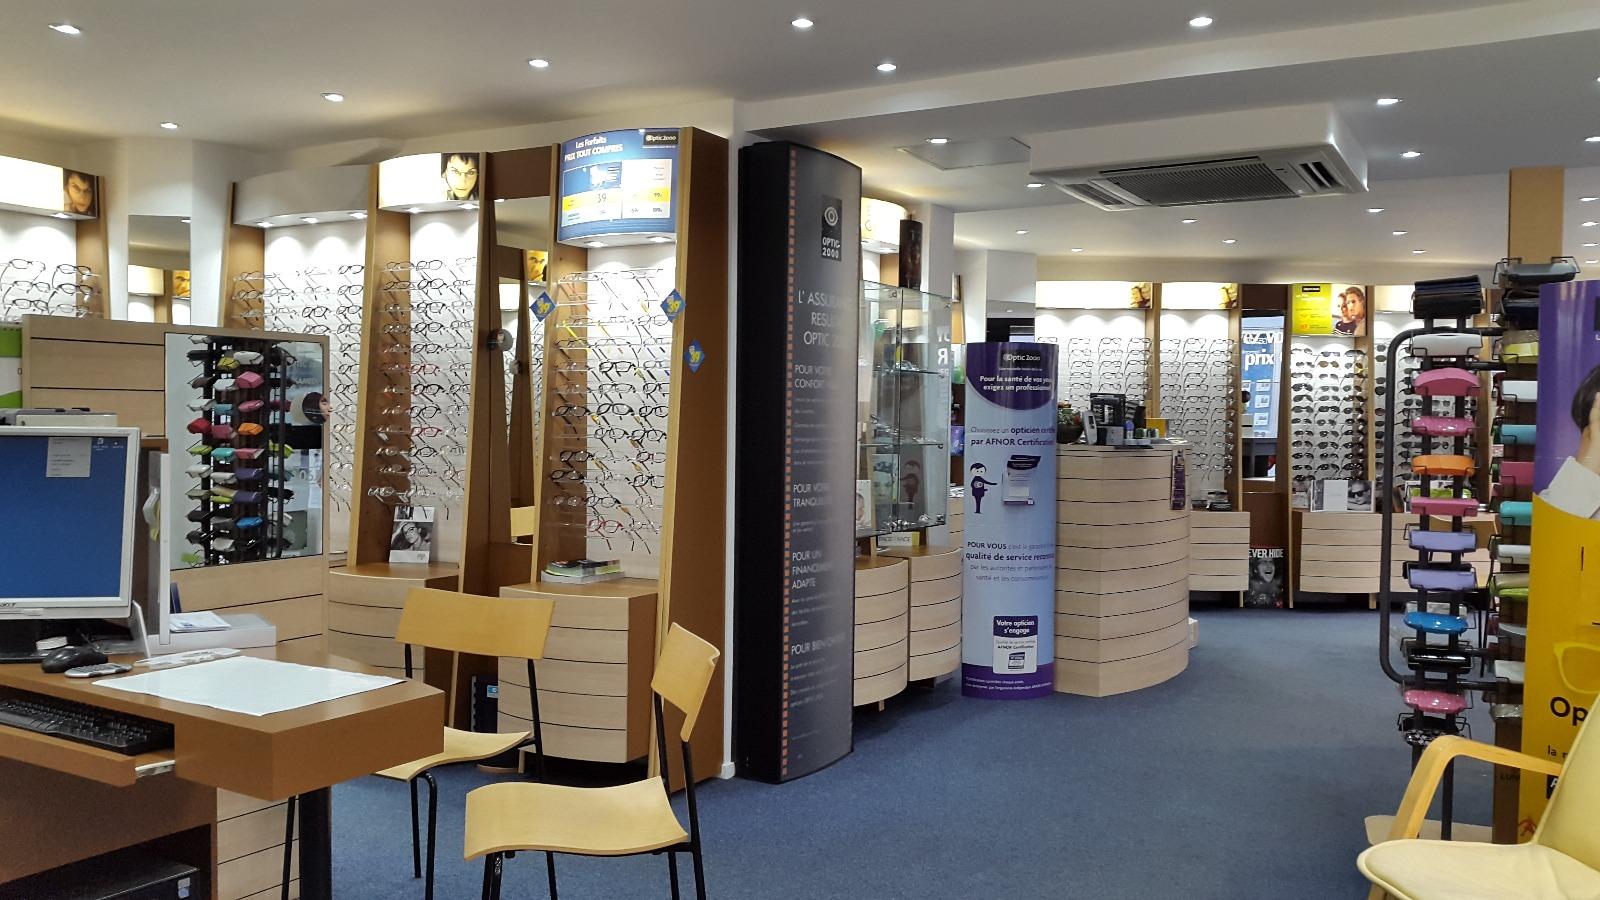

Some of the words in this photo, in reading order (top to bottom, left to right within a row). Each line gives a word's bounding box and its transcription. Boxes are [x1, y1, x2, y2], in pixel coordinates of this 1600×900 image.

[575, 141, 585, 149] Les
[585, 136, 607, 147] Forfaits
[564, 151, 576, 163] PRIX
[576, 149, 591, 159] TOUT
[591, 144, 624, 156] COMPRIS
[822, 237, 841, 248] OPTIC
[822, 247, 839, 259] 2000
[980, 375, 995, 383] Pour
[1004, 375, 1023, 383] santé
[1023, 375, 1032, 383] de
[983, 384, 1004, 392] exigez
[1010, 427, 1040, 436] opticien
[971, 439, 984, 447] par
[985, 438, 1015, 446] AFNOR
[967, 541, 986, 549] POUR
[986, 542, 1007, 550] VOUS
[965, 551, 992, 561] qualité
[993, 553, 1004, 561] de
[1006, 553, 1033, 561] service
[1268, 548, 1285, 559] HIDE
[1013, 619, 1035, 627] opticien
[1003, 626, 1030, 635] s'engage
[791, 642, 811, 655] POUR
[1549, 696, 1589, 727] Op
[1547, 745, 1557, 757] la
